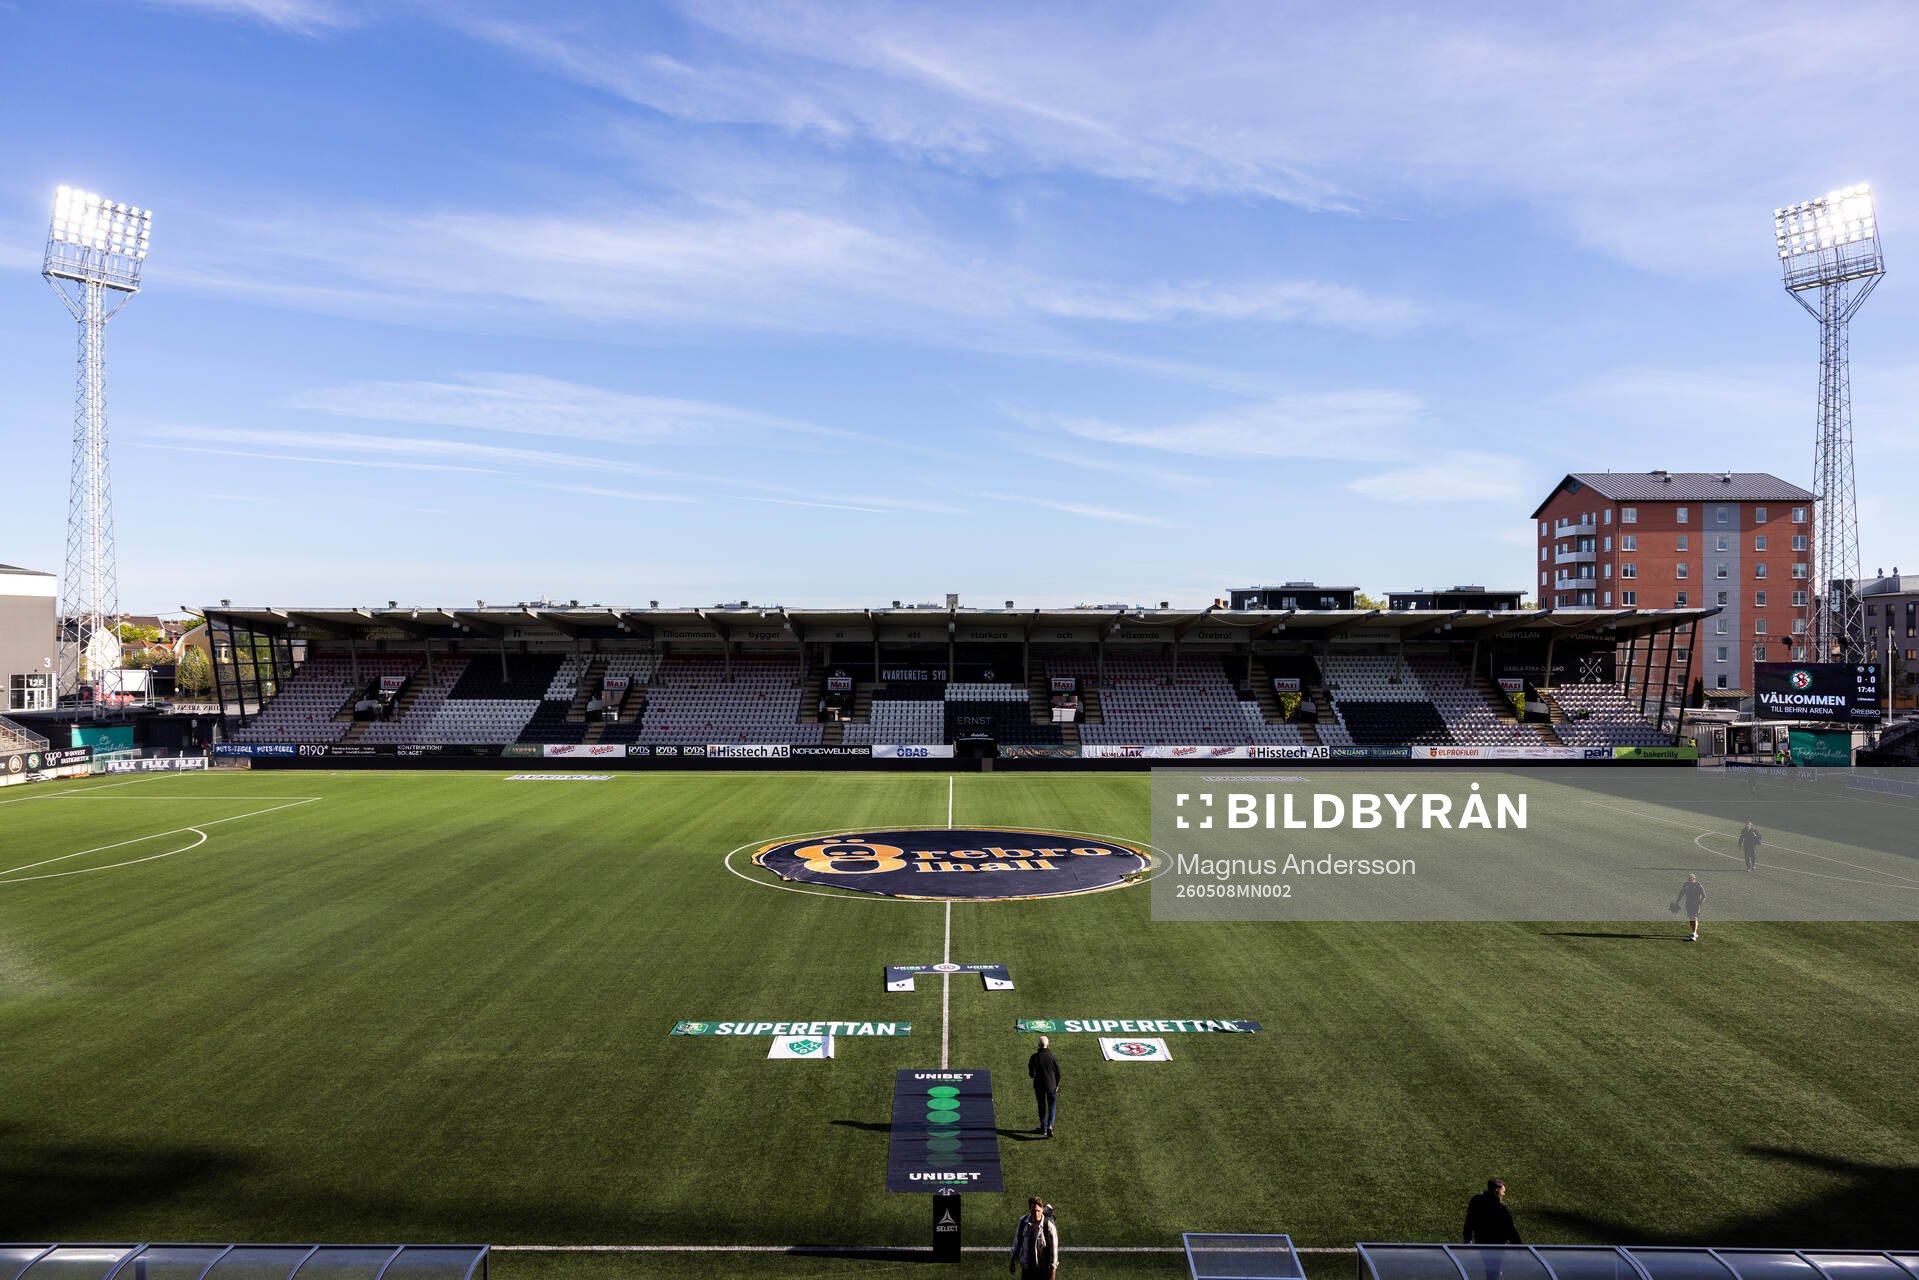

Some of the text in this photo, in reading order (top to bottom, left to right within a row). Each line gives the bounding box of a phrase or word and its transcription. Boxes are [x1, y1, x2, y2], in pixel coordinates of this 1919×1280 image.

[749, 632, 780, 641] bygger
[1057, 631, 1073, 639] och
[44, 657, 51, 668] 3
[882, 669, 920, 681] KVARTERET
[29, 679, 45, 687] 12E
[1856, 676, 1862, 684] 0
[1870, 676, 1876, 684] 0
[1760, 692, 1846, 706] VÄLKOMMEN
[1850, 707, 1881, 716] ÖREBRO
[957, 716, 992, 725] ERNST
[718, 746, 789, 757] Hisstech AB
[792, 747, 870, 755] NORDICWELLNESS
[1257, 747, 1329, 758] Hisstech AB
[1584, 748, 1613, 759] pahl
[108, 762, 136, 771] FLEX
[142, 760, 170, 769] FLEX
[715, 1021, 896, 1036] SUPERETTAN
[909, 1172, 981, 1181] UNIBET
